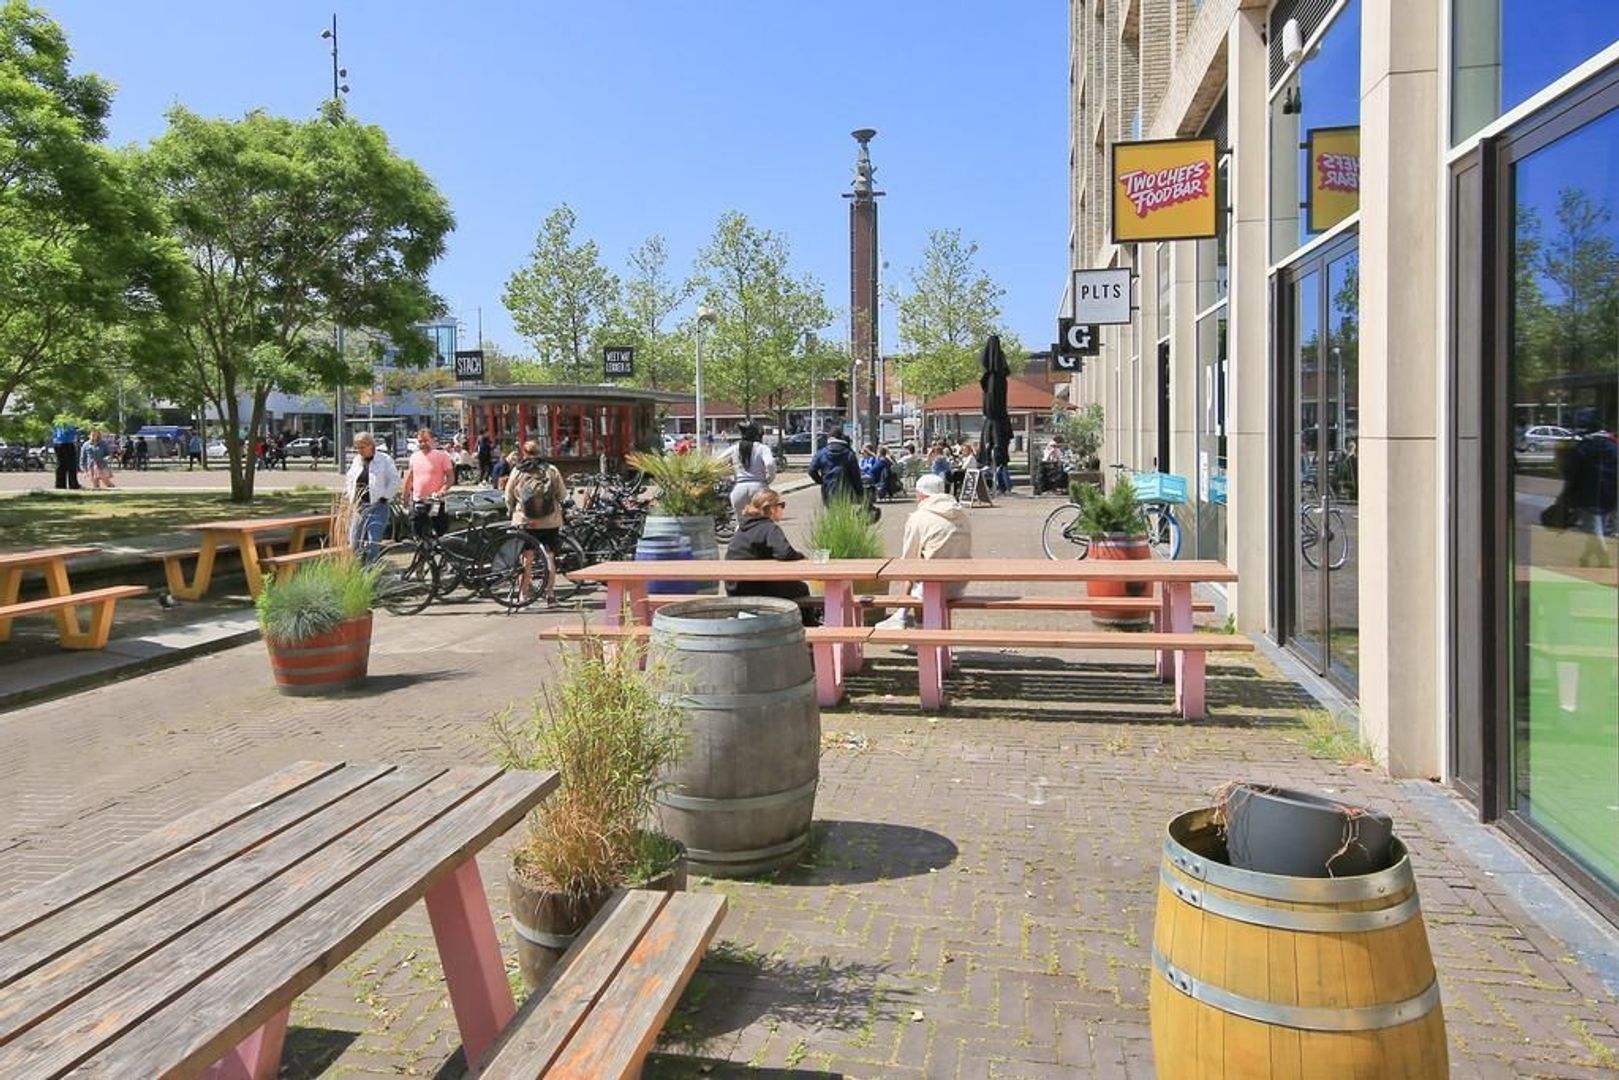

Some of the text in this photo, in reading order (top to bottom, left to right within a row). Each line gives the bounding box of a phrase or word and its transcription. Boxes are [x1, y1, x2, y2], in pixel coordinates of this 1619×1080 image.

[1120, 161, 1206, 195] TWO CHEFS
[1130, 180, 1204, 214] FOOD BAR
[1081, 283, 1121, 300] PLTS
[1067, 325, 1092, 349] G
[457, 357, 482, 376] STACH
